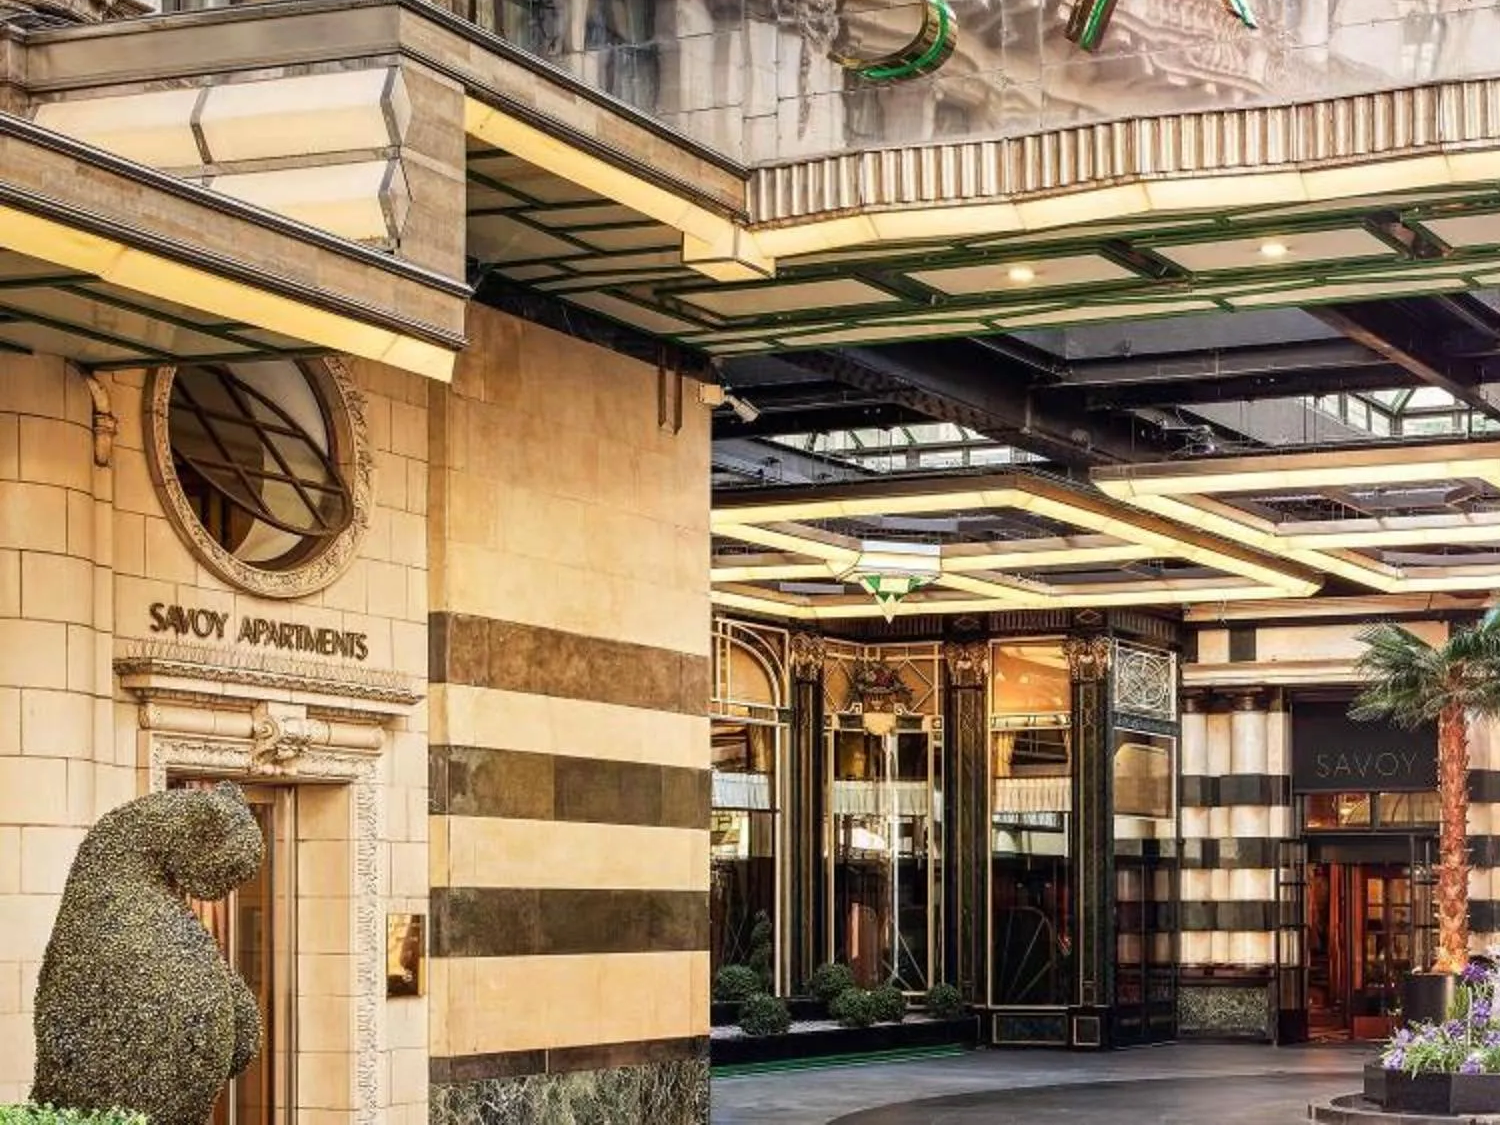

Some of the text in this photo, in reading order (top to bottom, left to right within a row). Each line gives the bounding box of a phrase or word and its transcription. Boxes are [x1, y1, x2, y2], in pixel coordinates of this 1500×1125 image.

[150, 602, 368, 661] SAVOY APARTMENTS
[1316, 752, 1417, 778] SAVOY
